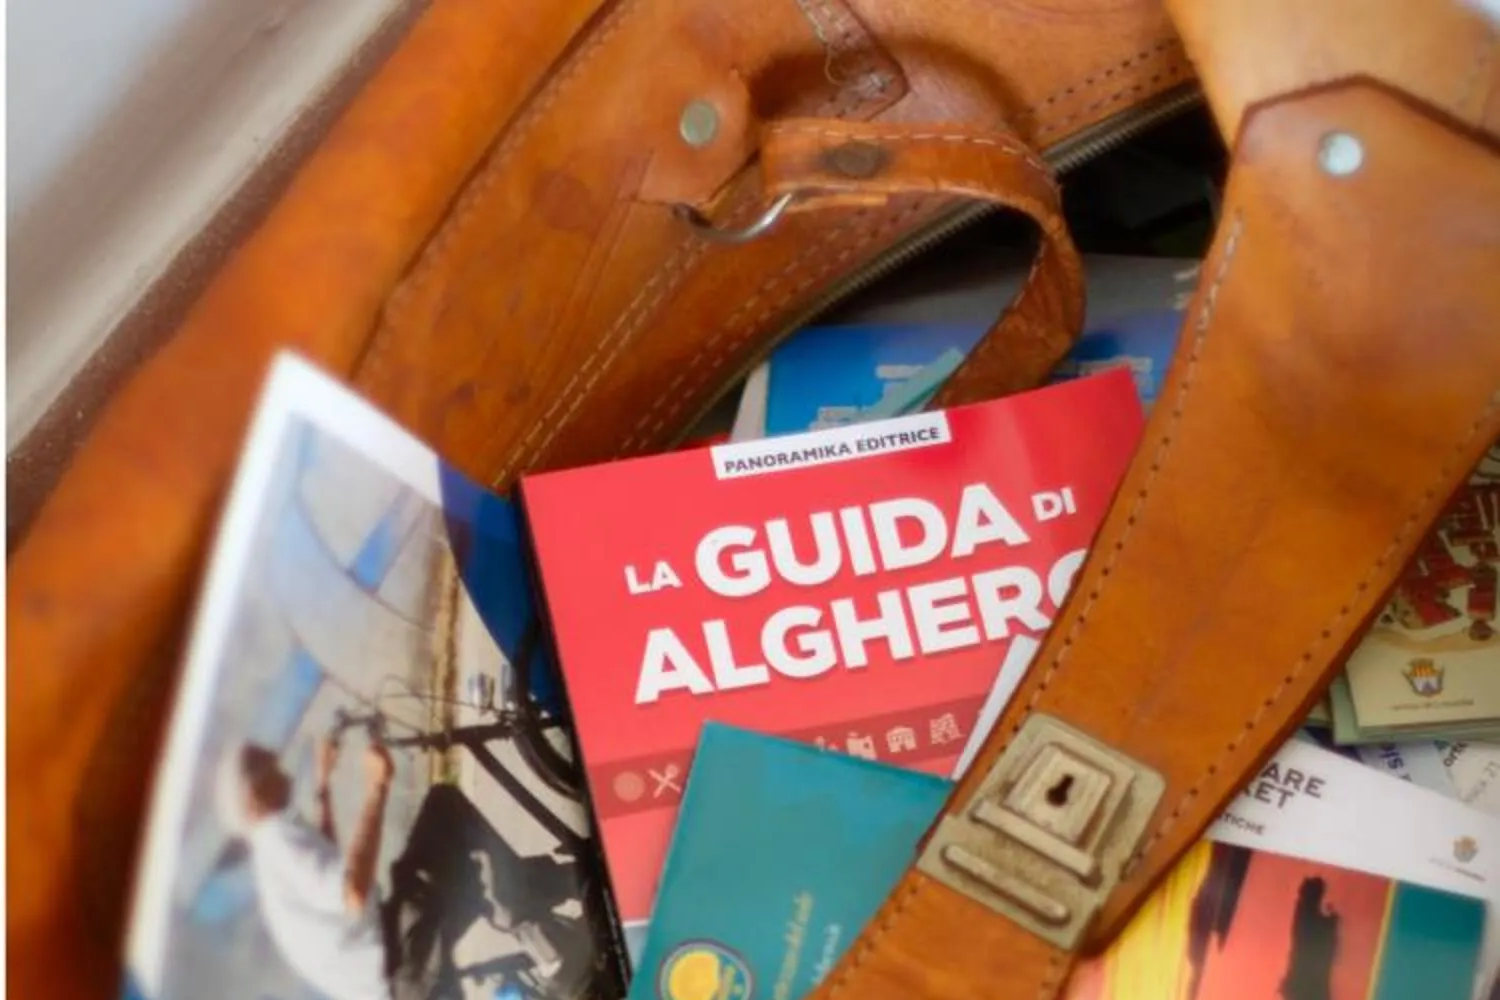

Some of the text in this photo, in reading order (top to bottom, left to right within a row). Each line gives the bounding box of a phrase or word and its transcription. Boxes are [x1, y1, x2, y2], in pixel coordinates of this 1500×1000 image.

[724, 427, 940, 474] PANORAMIKA EDITRICE
[624, 483, 1075, 597] LA GUIDA DI
[1260, 762, 1326, 799] ARE
